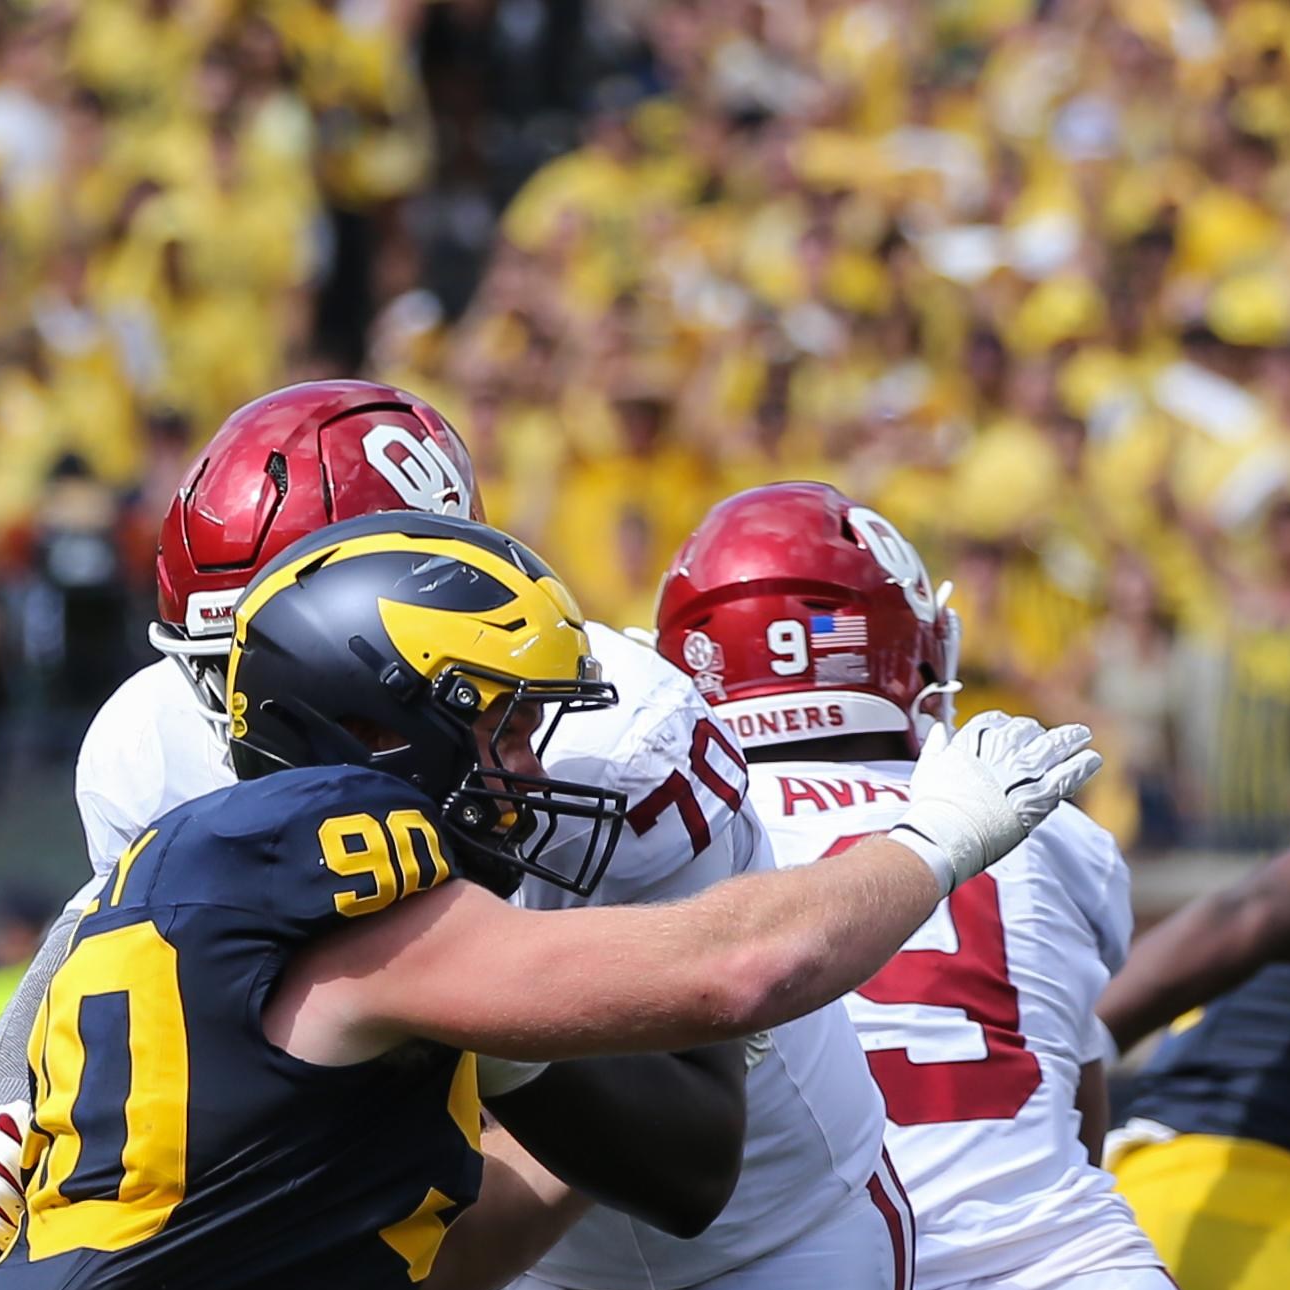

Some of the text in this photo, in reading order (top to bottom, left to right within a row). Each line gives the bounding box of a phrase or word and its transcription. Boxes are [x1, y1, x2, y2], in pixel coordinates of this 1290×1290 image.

[361, 423, 472, 519] OU
[766, 619, 810, 677] 9
[625, 716, 749, 862] 70
[775, 776, 911, 817] AVA
[317, 808, 451, 918] 90
[820, 829, 1044, 1127] 9
